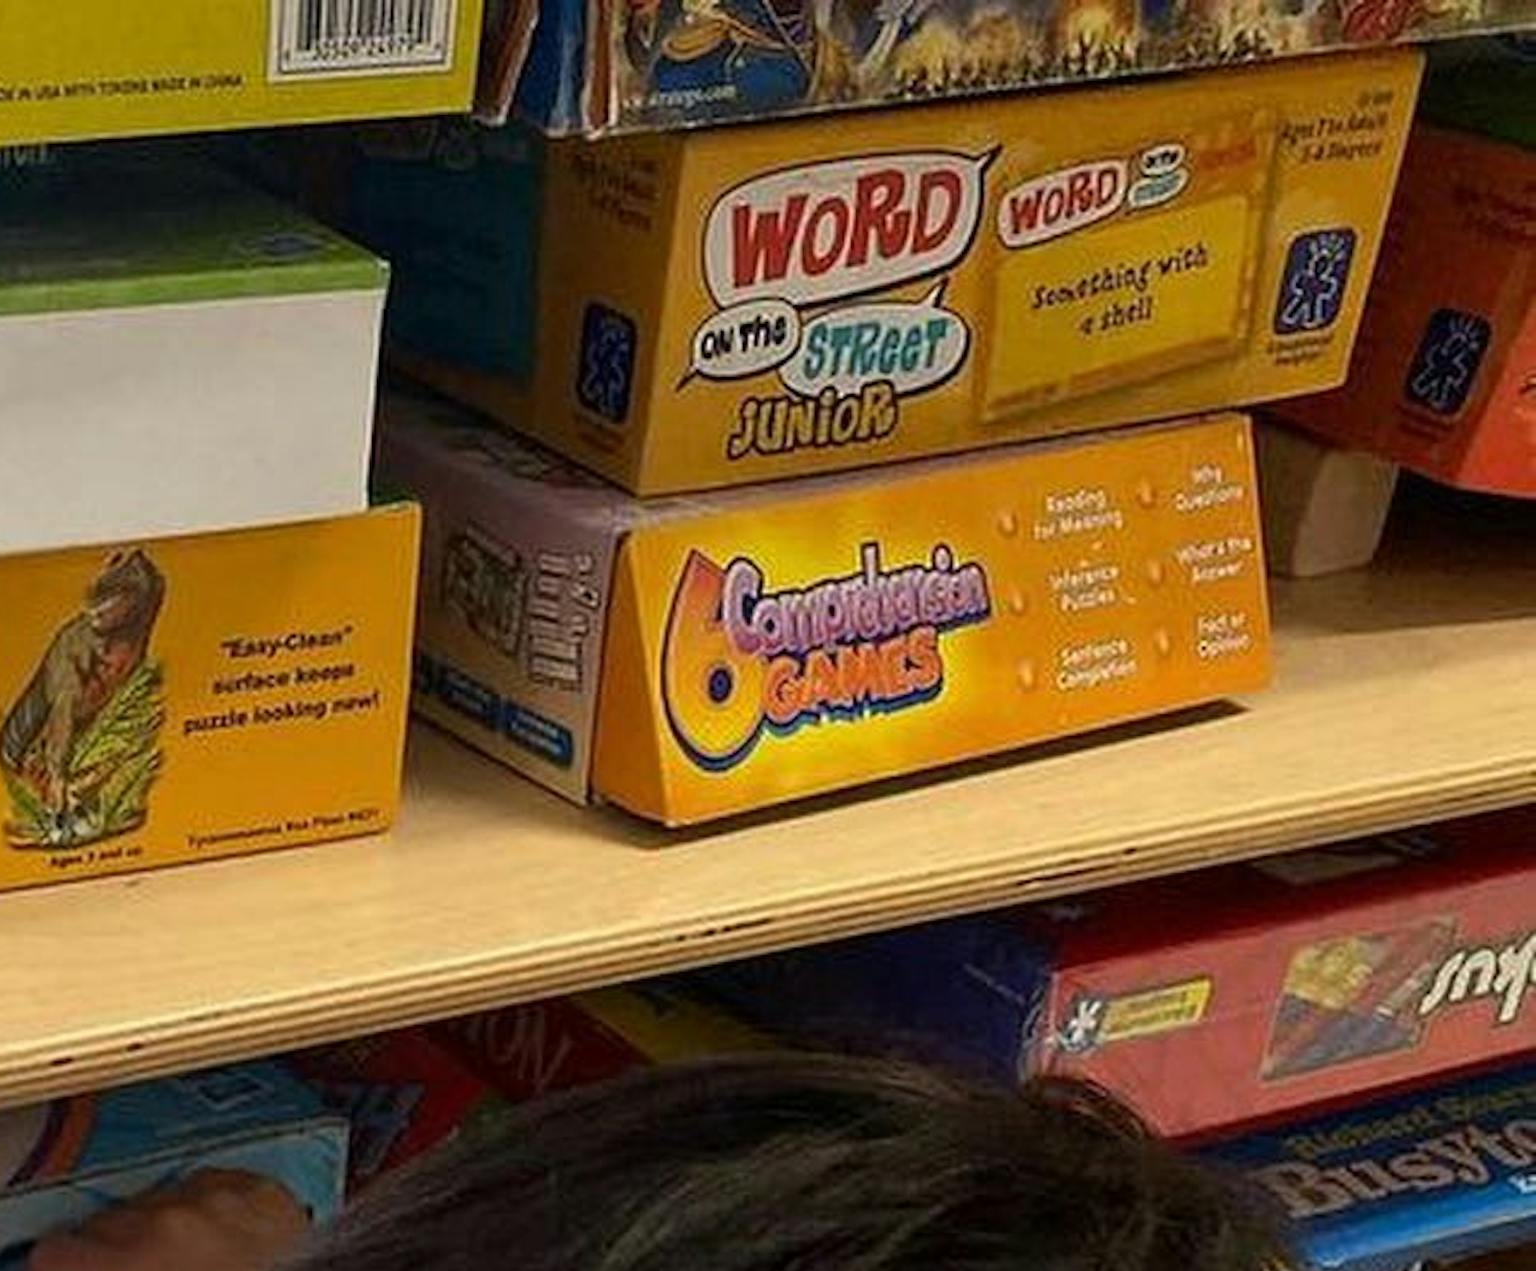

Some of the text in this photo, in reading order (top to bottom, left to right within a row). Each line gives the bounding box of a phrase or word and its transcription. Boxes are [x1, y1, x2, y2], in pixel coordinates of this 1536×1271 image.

[733, 169, 962, 289] WORD
[1009, 168, 1118, 234] WORD
[1032, 243, 1208, 309] Something with
[1080, 297, 1153, 335] a shell
[1060, 510, 1123, 533] Meaning
[1176, 486, 1244, 511] Questions
[213, 663, 355, 694] surface keeps
[661, 549, 767, 772] 6
[764, 626, 942, 729] GAMES
[184, 689, 380, 736] puzzle looking new!
[1416, 932, 1536, 1026] kus
